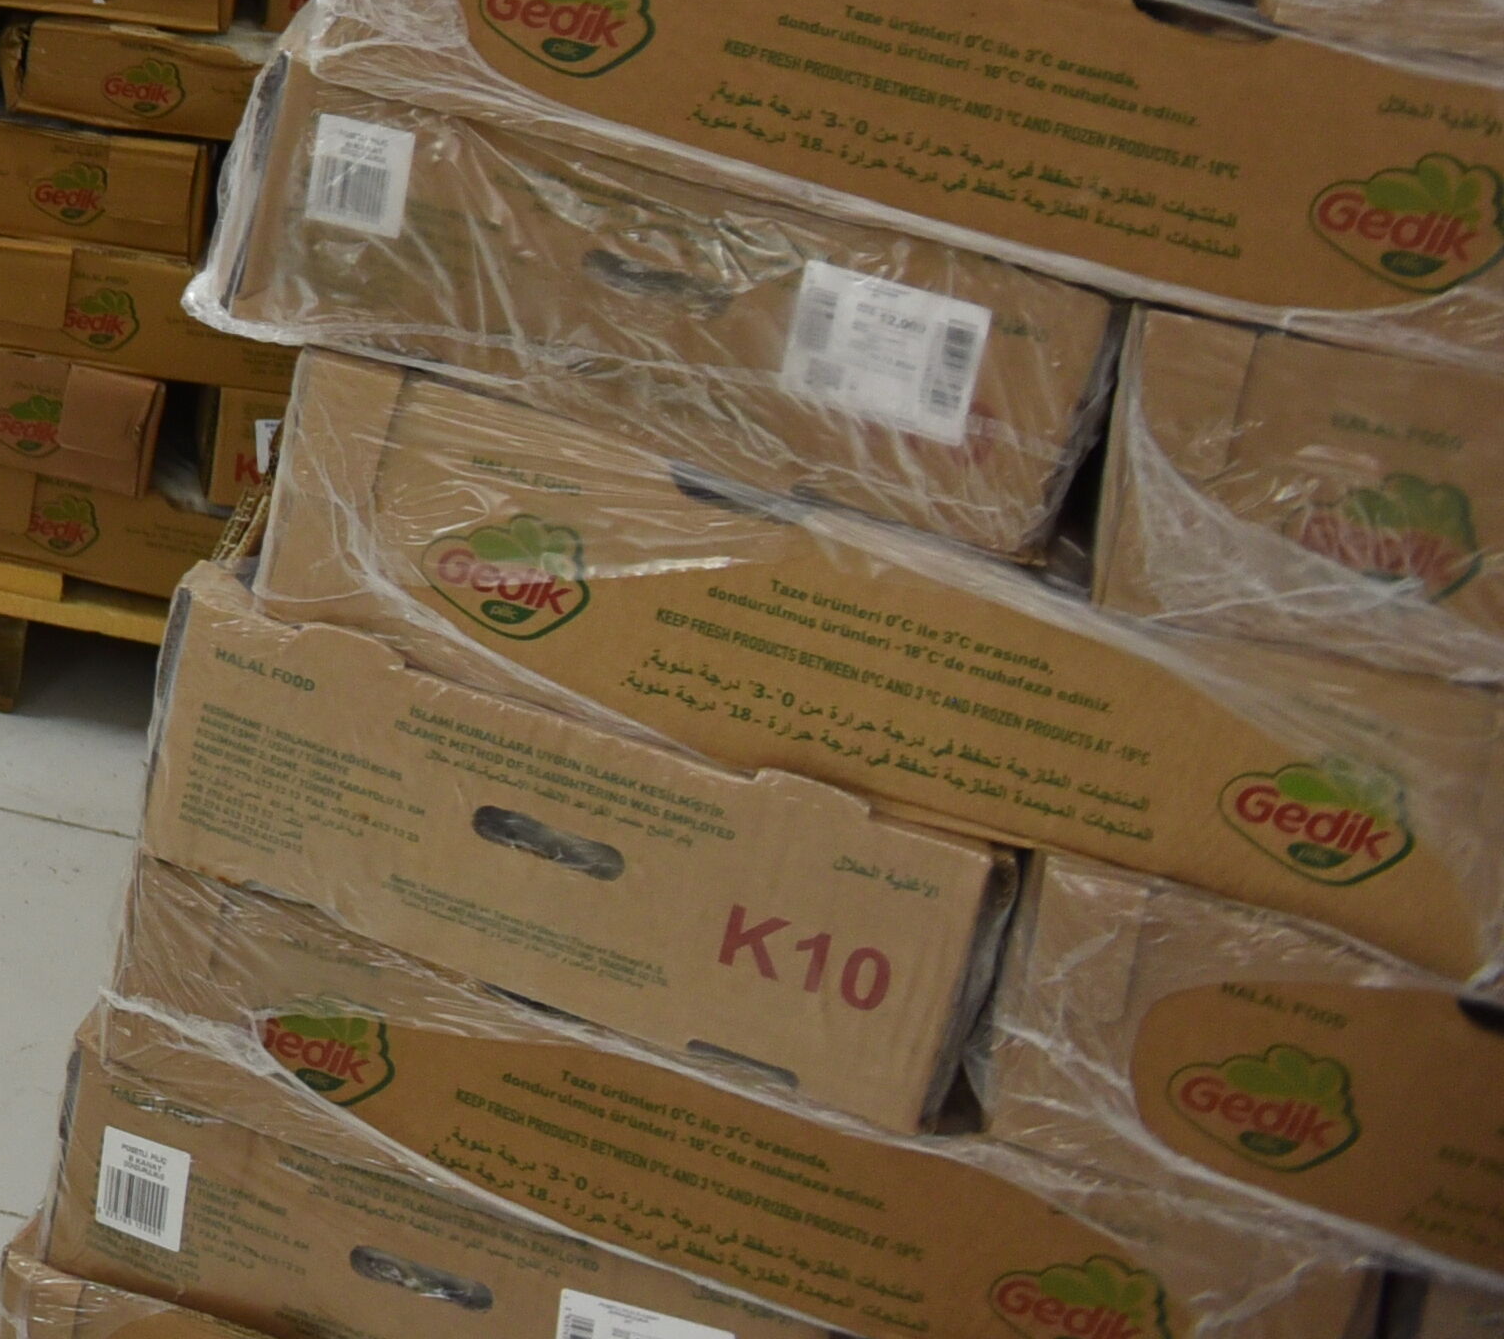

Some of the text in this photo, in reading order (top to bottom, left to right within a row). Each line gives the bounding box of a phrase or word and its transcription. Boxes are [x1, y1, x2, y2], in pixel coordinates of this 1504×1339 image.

[103, 75, 173, 104] Gedik
[1317, 189, 1482, 262] Gedik
[438, 547, 573, 615] Gedik
[771, 578, 1054, 675] Taze ürünleri 0°C ile 3°C arasında,
[214, 647, 317, 693] HALAL FOOD
[656, 607, 1152, 768] KEEP FRESH PRODUCTS BETWEEN 0°C AND 3 °C AND FROZEN PRODUCTS AT -18°C
[393, 718, 737, 842] ISLAMIC METHOD OF SLAUGHTERING WAS EMPLOYED
[409, 704, 727, 821] İSLAMİ KURALLARA UYGUN OLARAK KESİLMİŞTİR.
[1236, 785, 1390, 862] Gedik
[718, 903, 891, 1013] K10
[1221, 980, 1350, 1029] HALAL FOOD
[1179, 1075, 1330, 1146] Gedik
